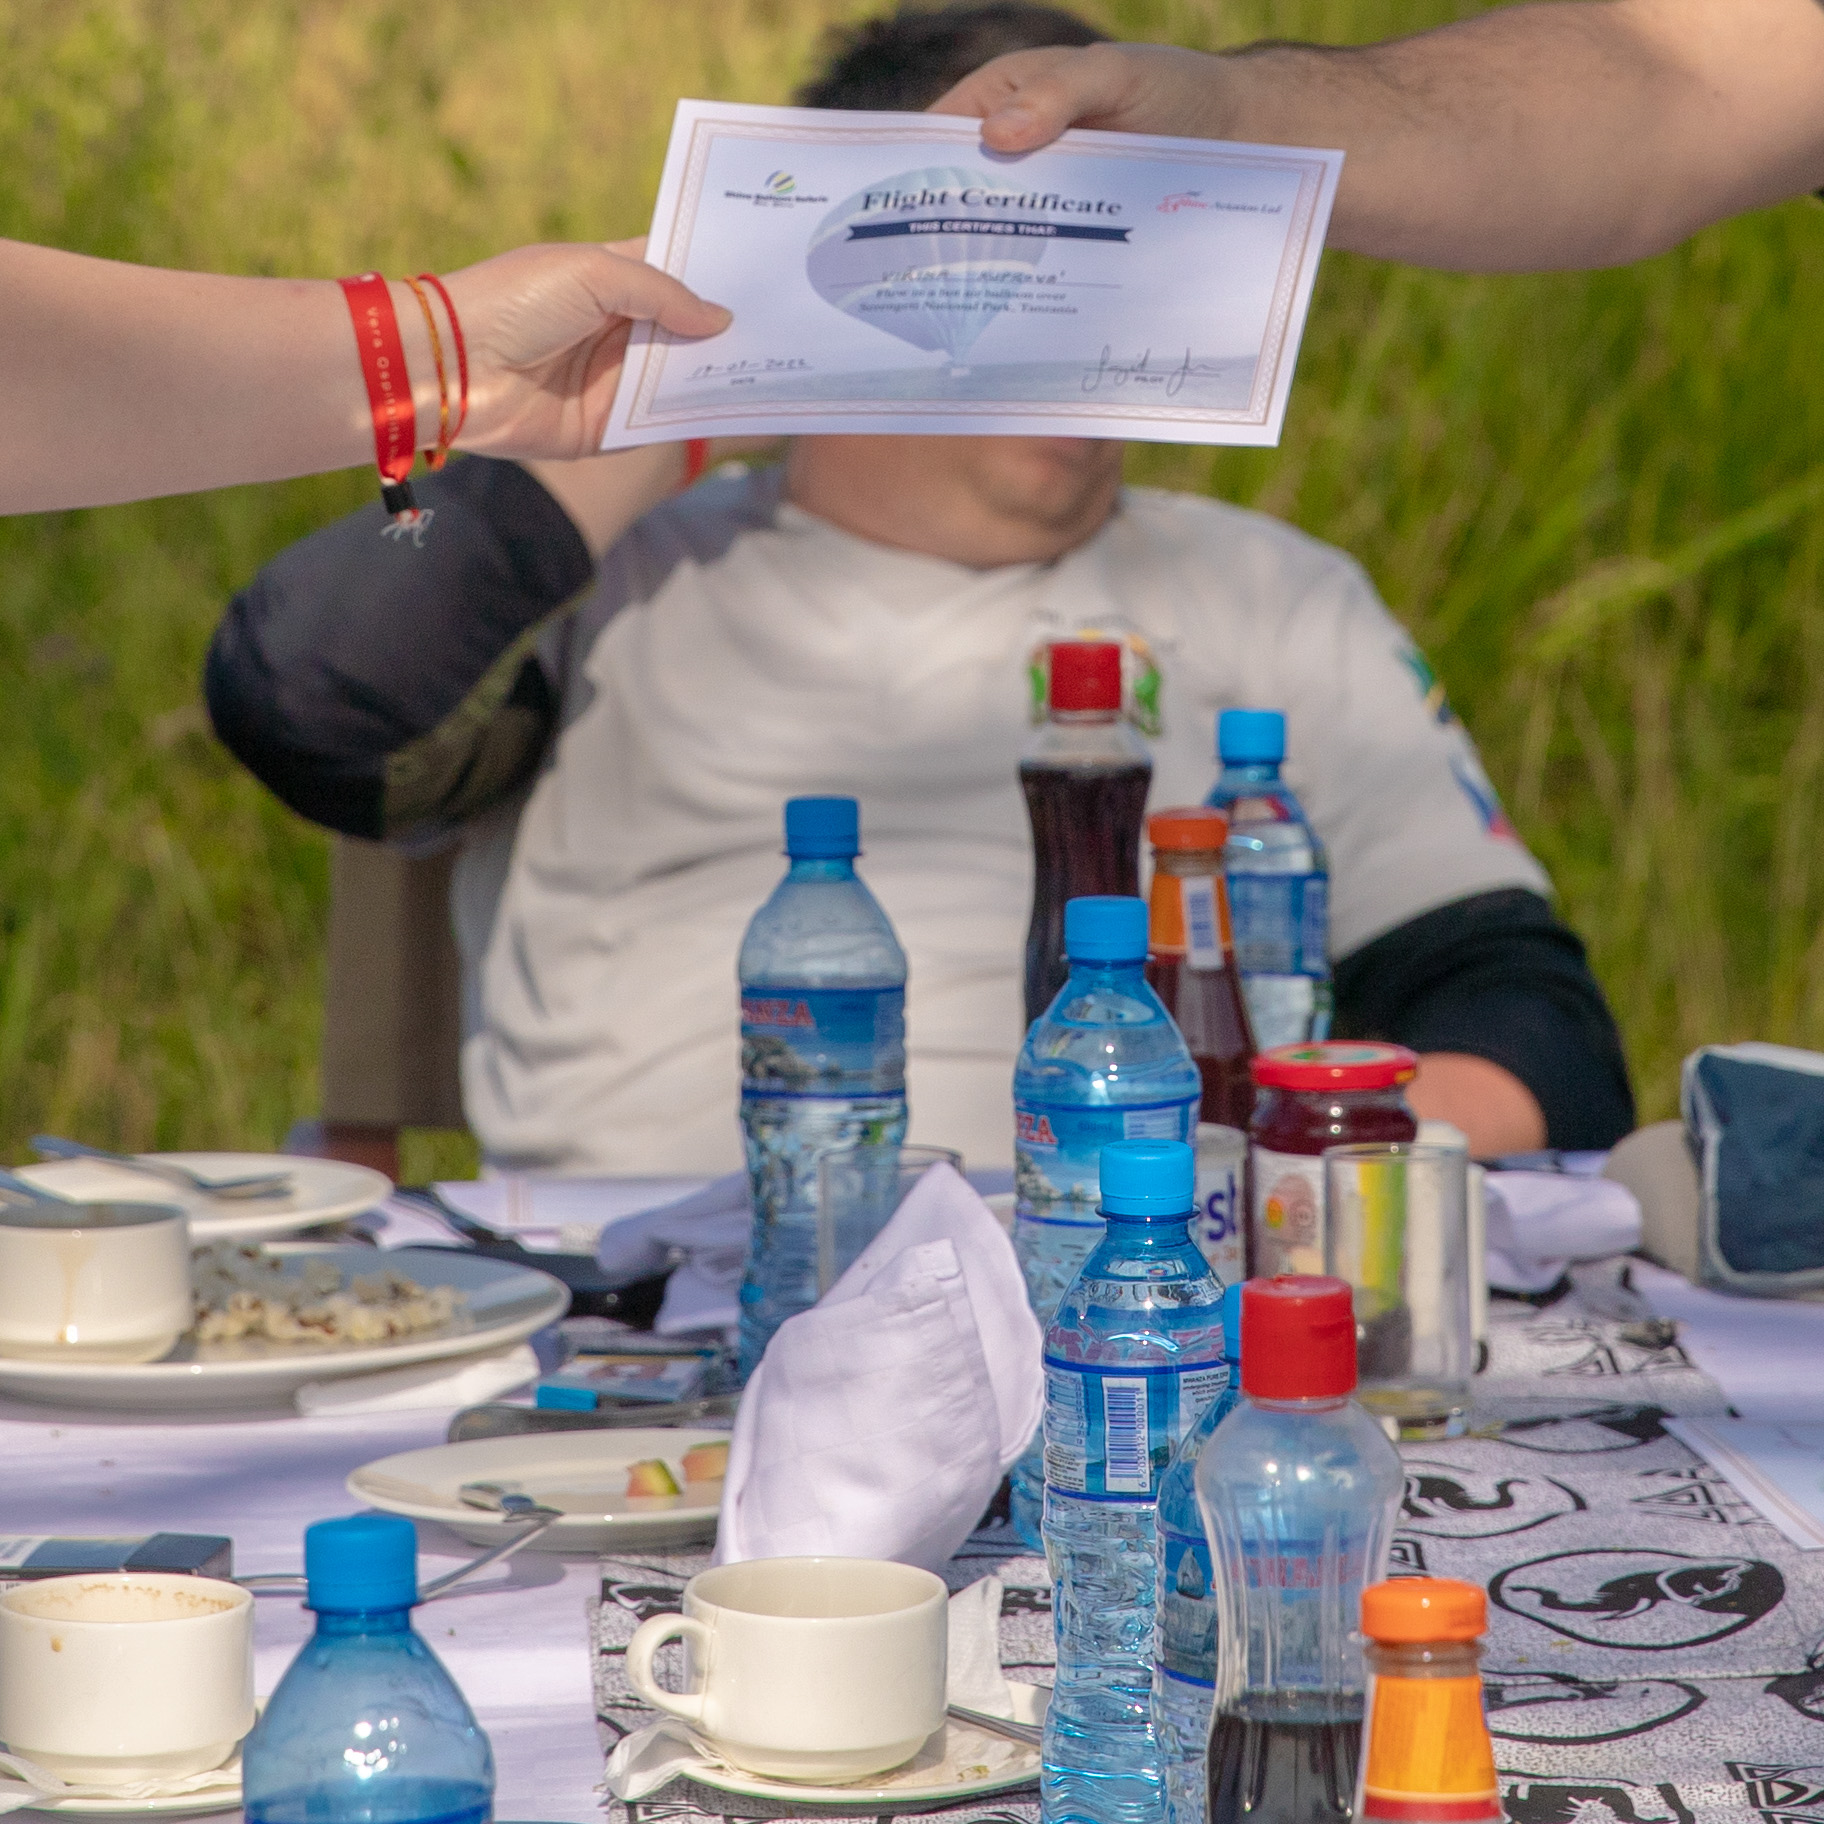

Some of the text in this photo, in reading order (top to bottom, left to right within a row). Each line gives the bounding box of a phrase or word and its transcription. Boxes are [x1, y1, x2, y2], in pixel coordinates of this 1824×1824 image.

[861, 186, 1124, 217] Flight Certificate
[909, 221, 941, 234] THIS
[942, 221, 1016, 235] CERTIFIES
[365, 305, 384, 350] Vera
